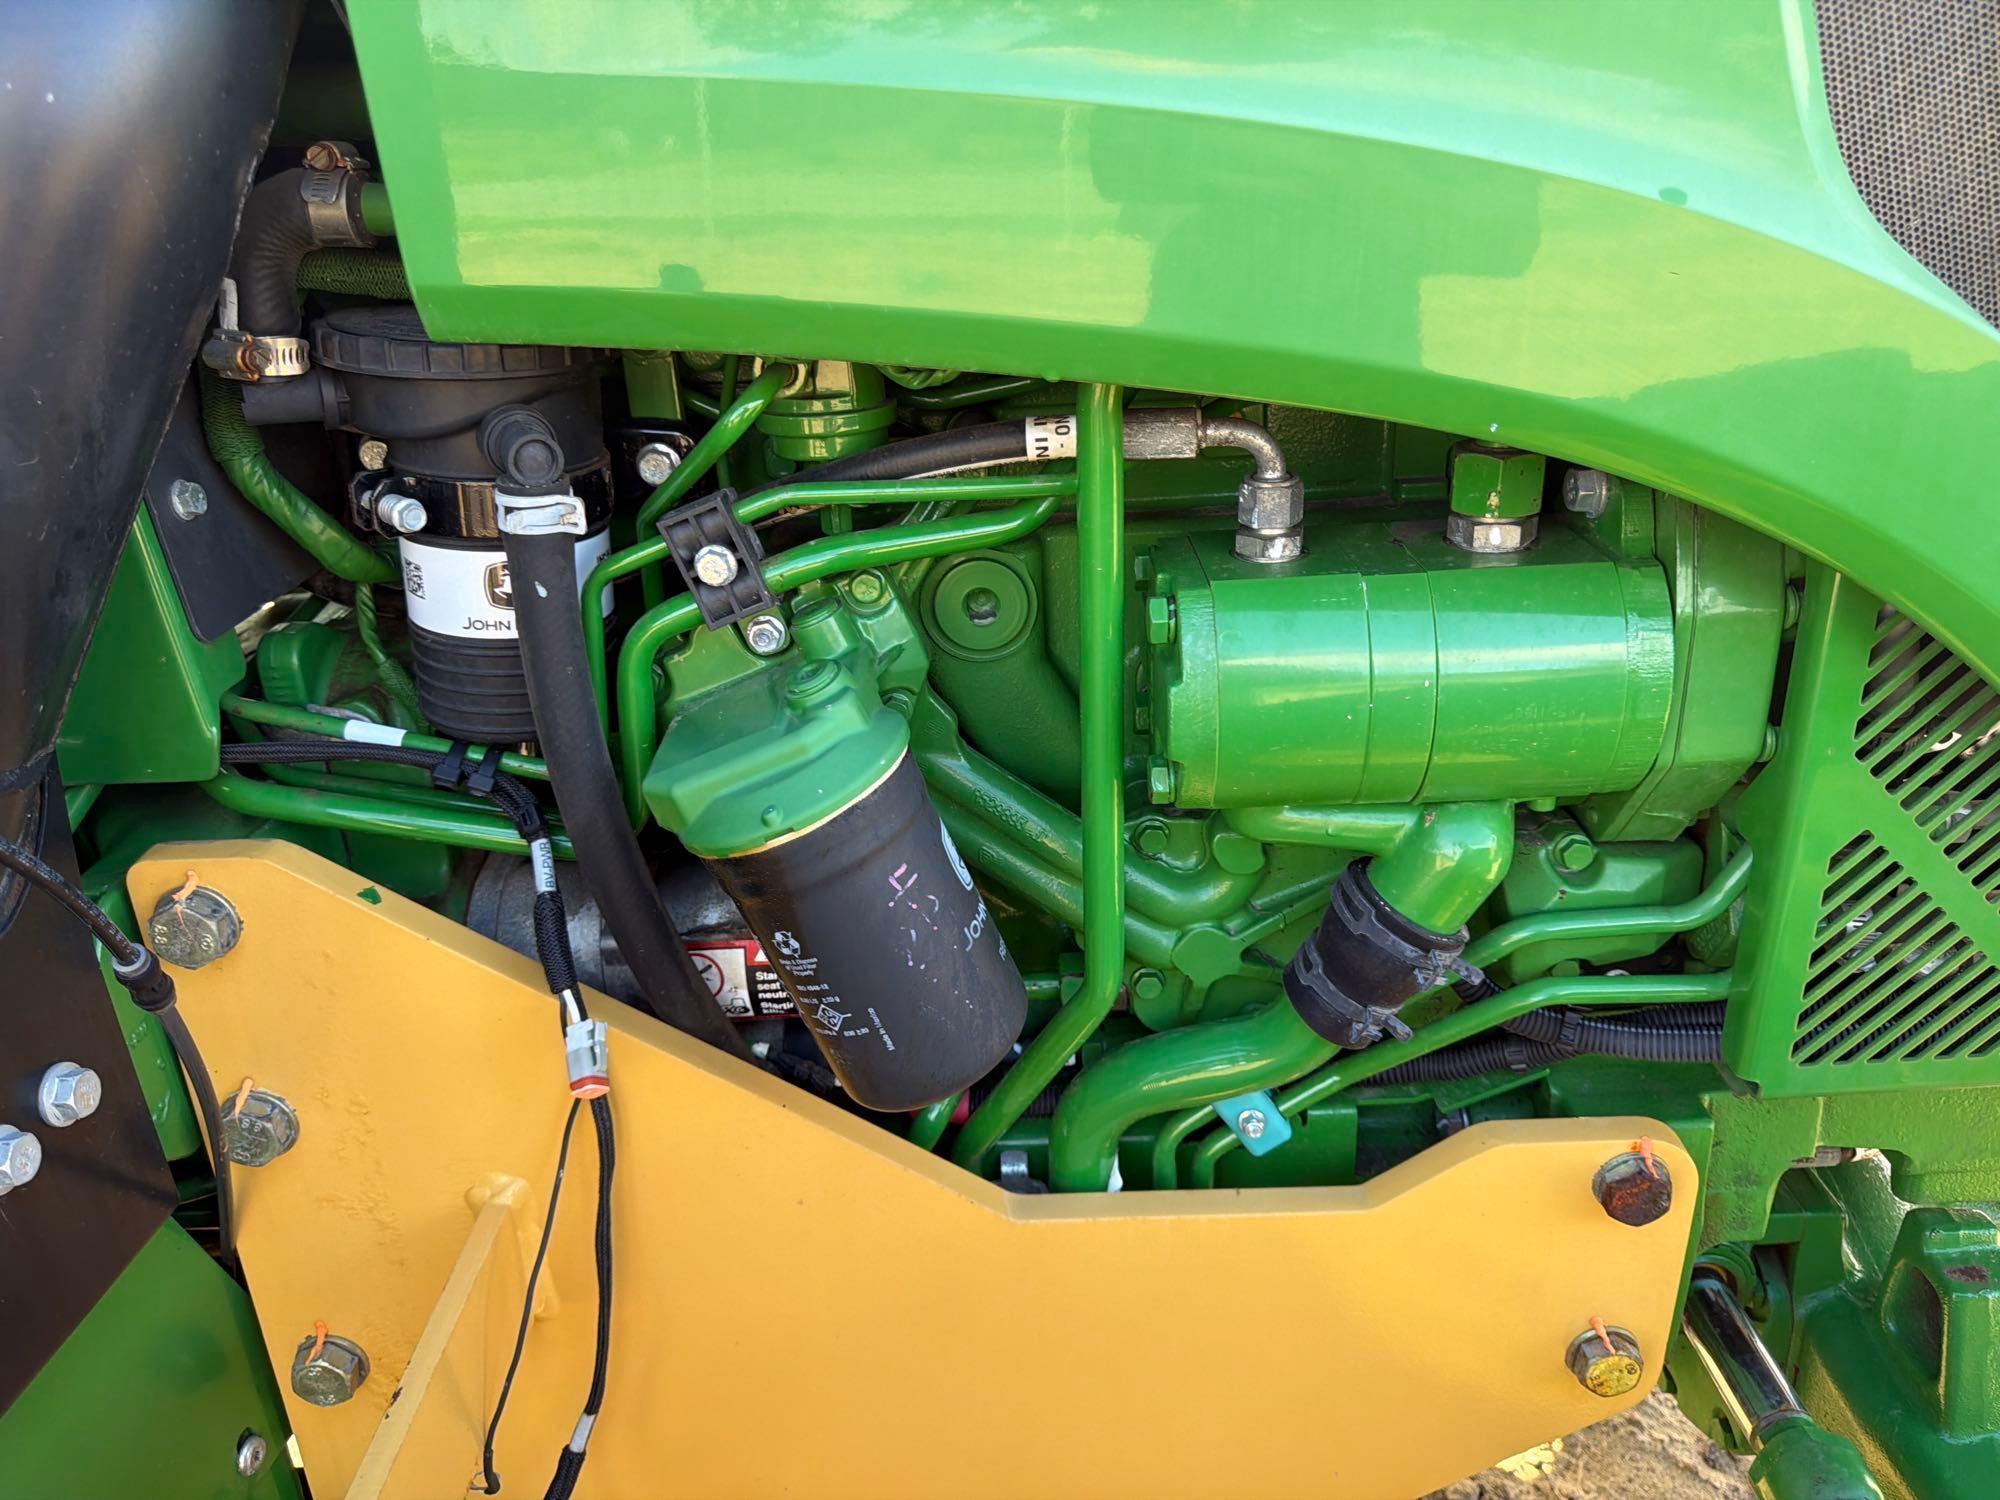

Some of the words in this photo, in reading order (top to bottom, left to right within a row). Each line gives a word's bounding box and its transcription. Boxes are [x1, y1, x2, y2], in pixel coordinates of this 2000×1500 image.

[463, 617, 511, 631] JOHN
[539, 841, 554, 888] BV-PWR
[757, 981, 780, 990] seat
[758, 991, 790, 999] neutr
